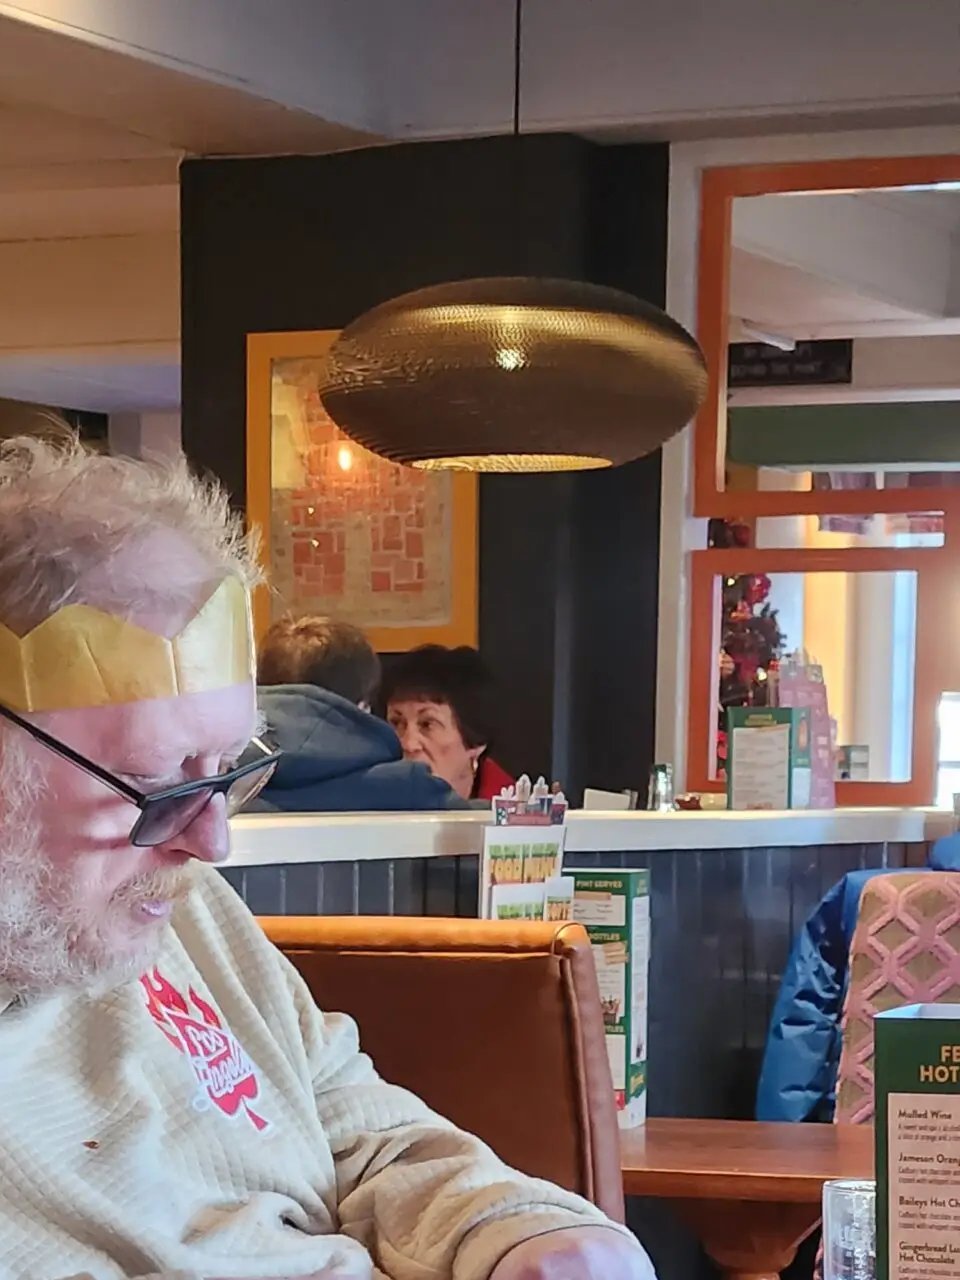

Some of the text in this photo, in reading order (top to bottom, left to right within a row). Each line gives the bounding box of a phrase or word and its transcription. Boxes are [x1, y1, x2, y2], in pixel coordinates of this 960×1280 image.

[919, 1065, 960, 1083] HOT
[899, 1196, 927, 1209] Baileys
[930, 1196, 946, 1208] Hot
[899, 1252, 955, 1265] Hot Chocolate
